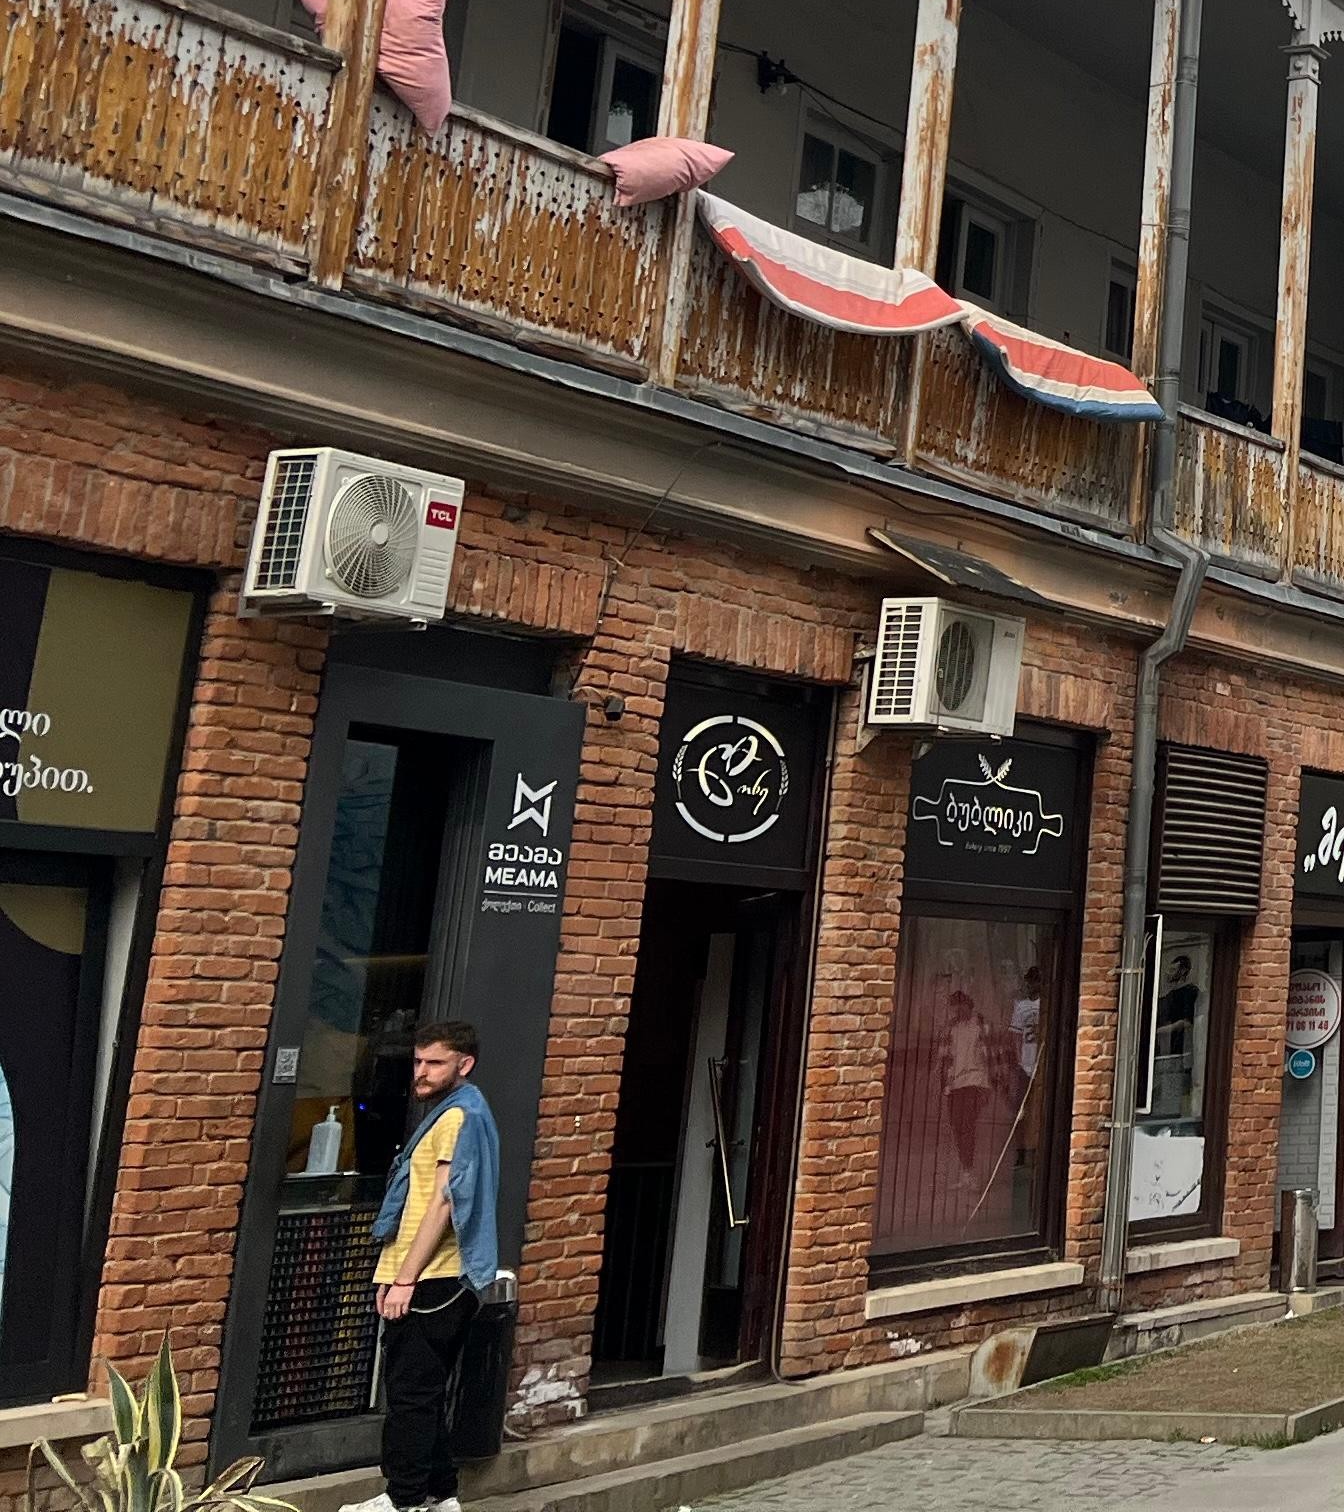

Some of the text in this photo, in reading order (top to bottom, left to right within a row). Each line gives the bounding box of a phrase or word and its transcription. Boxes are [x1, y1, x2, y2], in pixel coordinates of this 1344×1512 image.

[430, 508, 452, 522] TCL
[946, 792, 1033, 837] ბუბლიკი
[488, 843, 563, 865] მეამა
[485, 866, 558, 888] MEAMA
[528, 899, 556, 914] Collect
